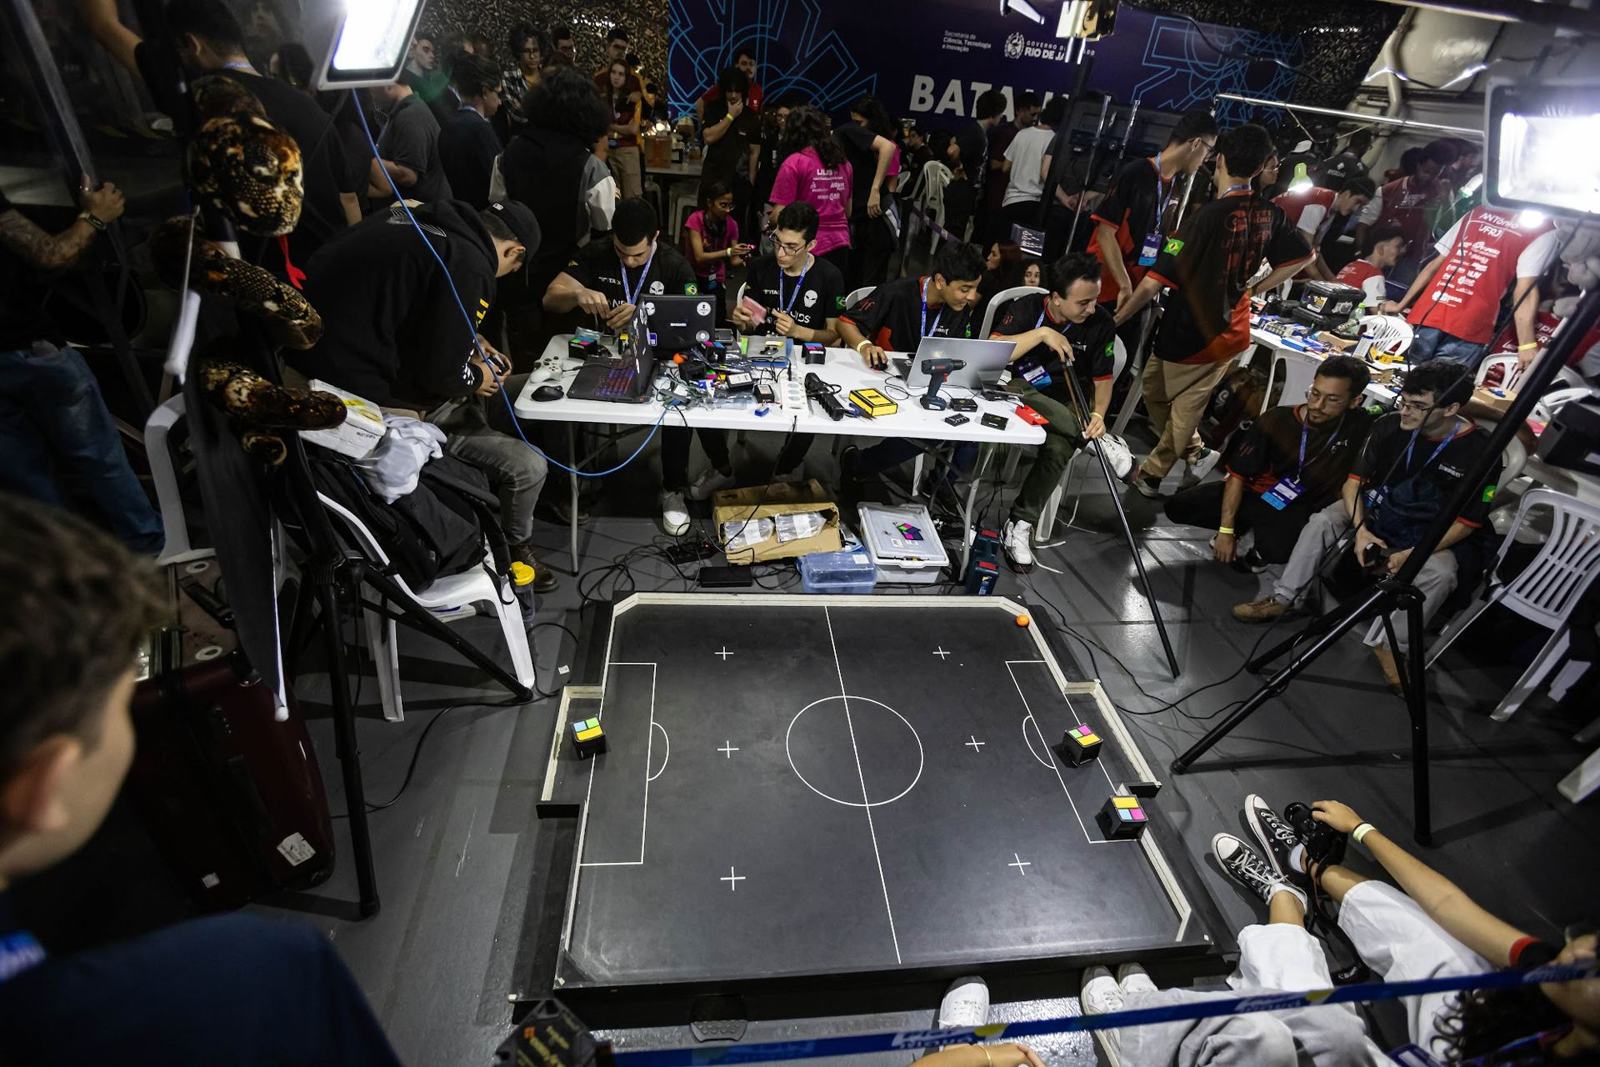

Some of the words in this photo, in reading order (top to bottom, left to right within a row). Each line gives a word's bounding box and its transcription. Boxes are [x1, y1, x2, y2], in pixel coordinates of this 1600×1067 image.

[964, 39, 991, 49] Tecnologia
[1026, 40, 1058, 50] GOVERNO
[1024, 46, 1040, 58] RIO
[1042, 49, 1055, 60] DE
